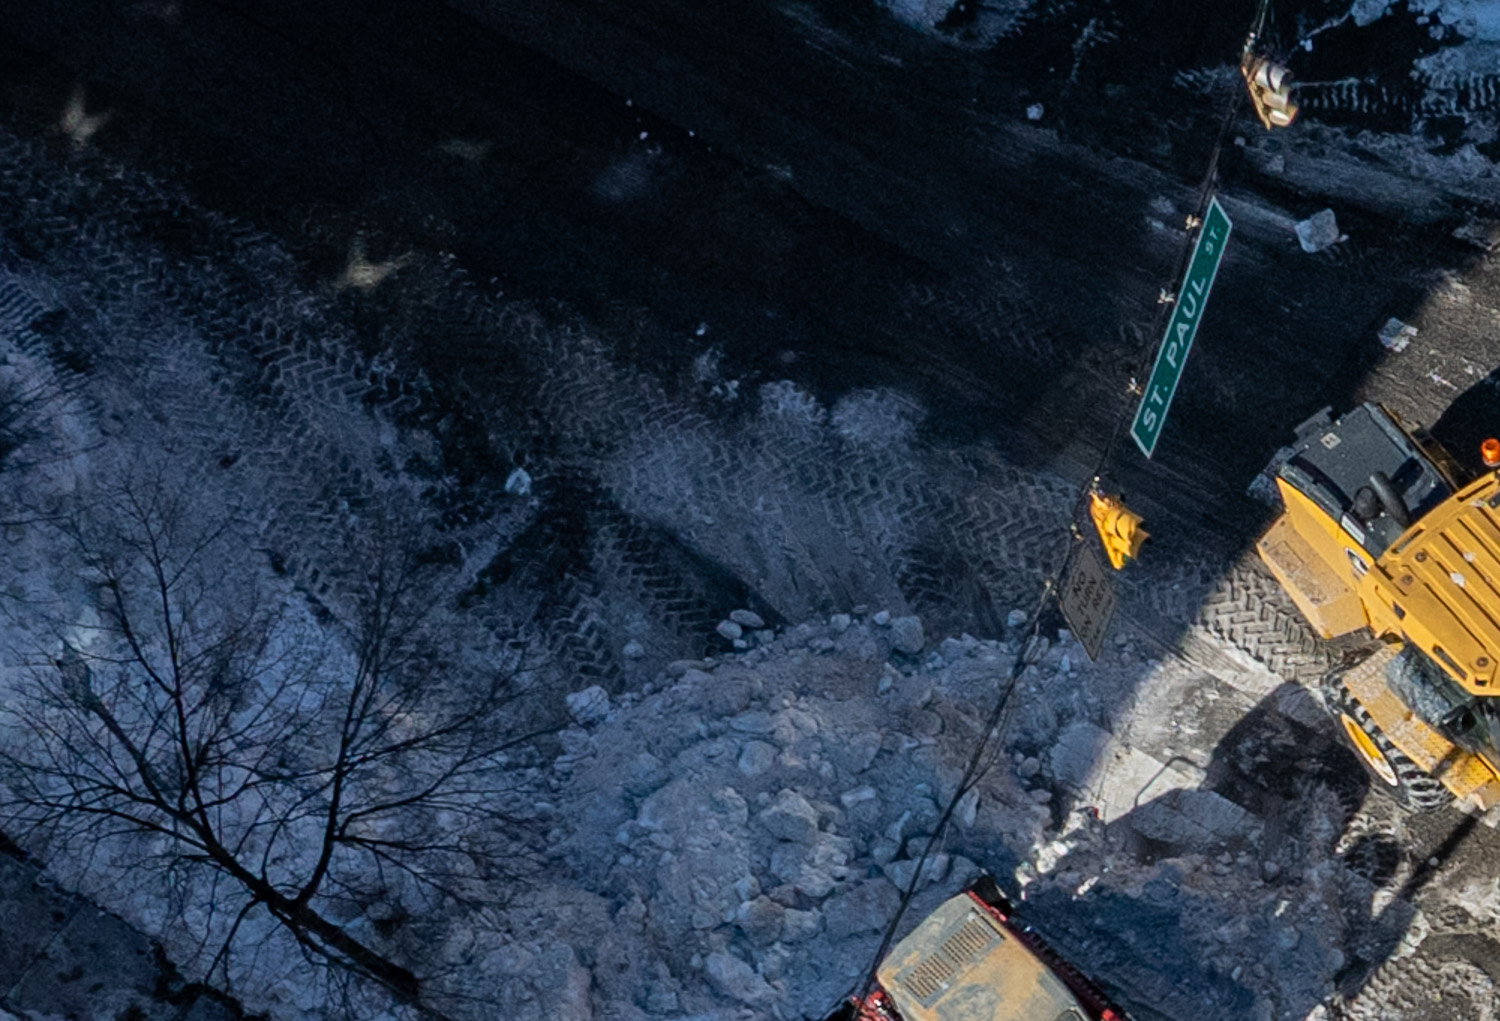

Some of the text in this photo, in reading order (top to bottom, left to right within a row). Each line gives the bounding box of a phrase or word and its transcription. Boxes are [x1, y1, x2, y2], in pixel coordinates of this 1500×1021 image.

[1143, 384, 1168, 432] ST.
[1166, 276, 1207, 369] PAUL
[1072, 570, 1086, 597] NO
[1077, 573, 1097, 616] TURN
[1080, 613, 1093, 639] ON
[1091, 577, 1107, 612] RED
